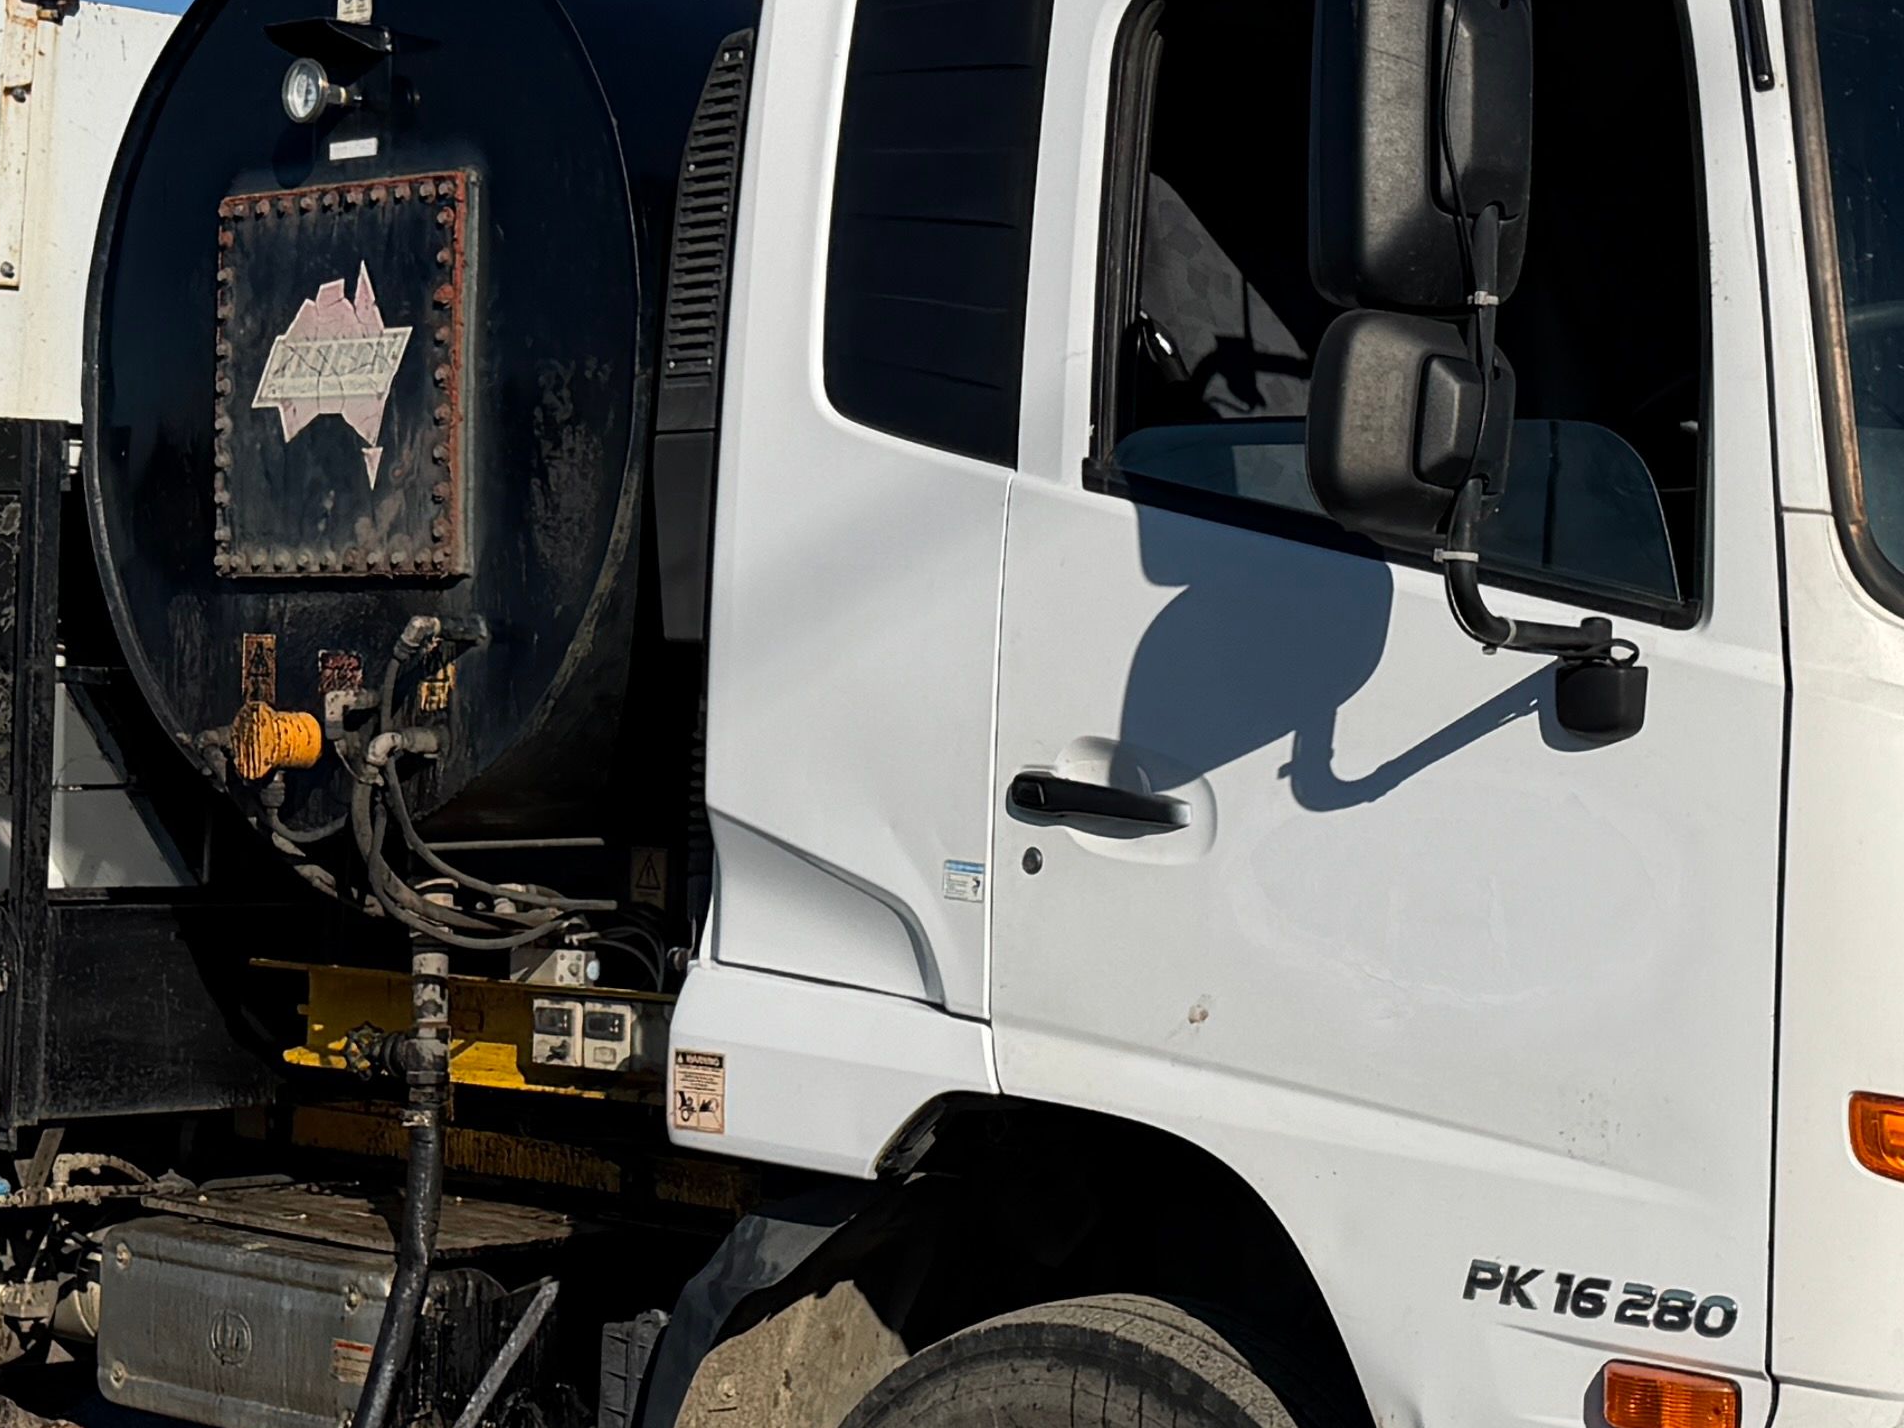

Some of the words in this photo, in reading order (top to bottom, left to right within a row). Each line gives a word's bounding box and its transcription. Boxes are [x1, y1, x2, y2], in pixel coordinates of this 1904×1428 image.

[1462, 1258, 1545, 1311] PK
[1553, 1271, 1612, 1319] 16
[1614, 1281, 1739, 1339] 280
